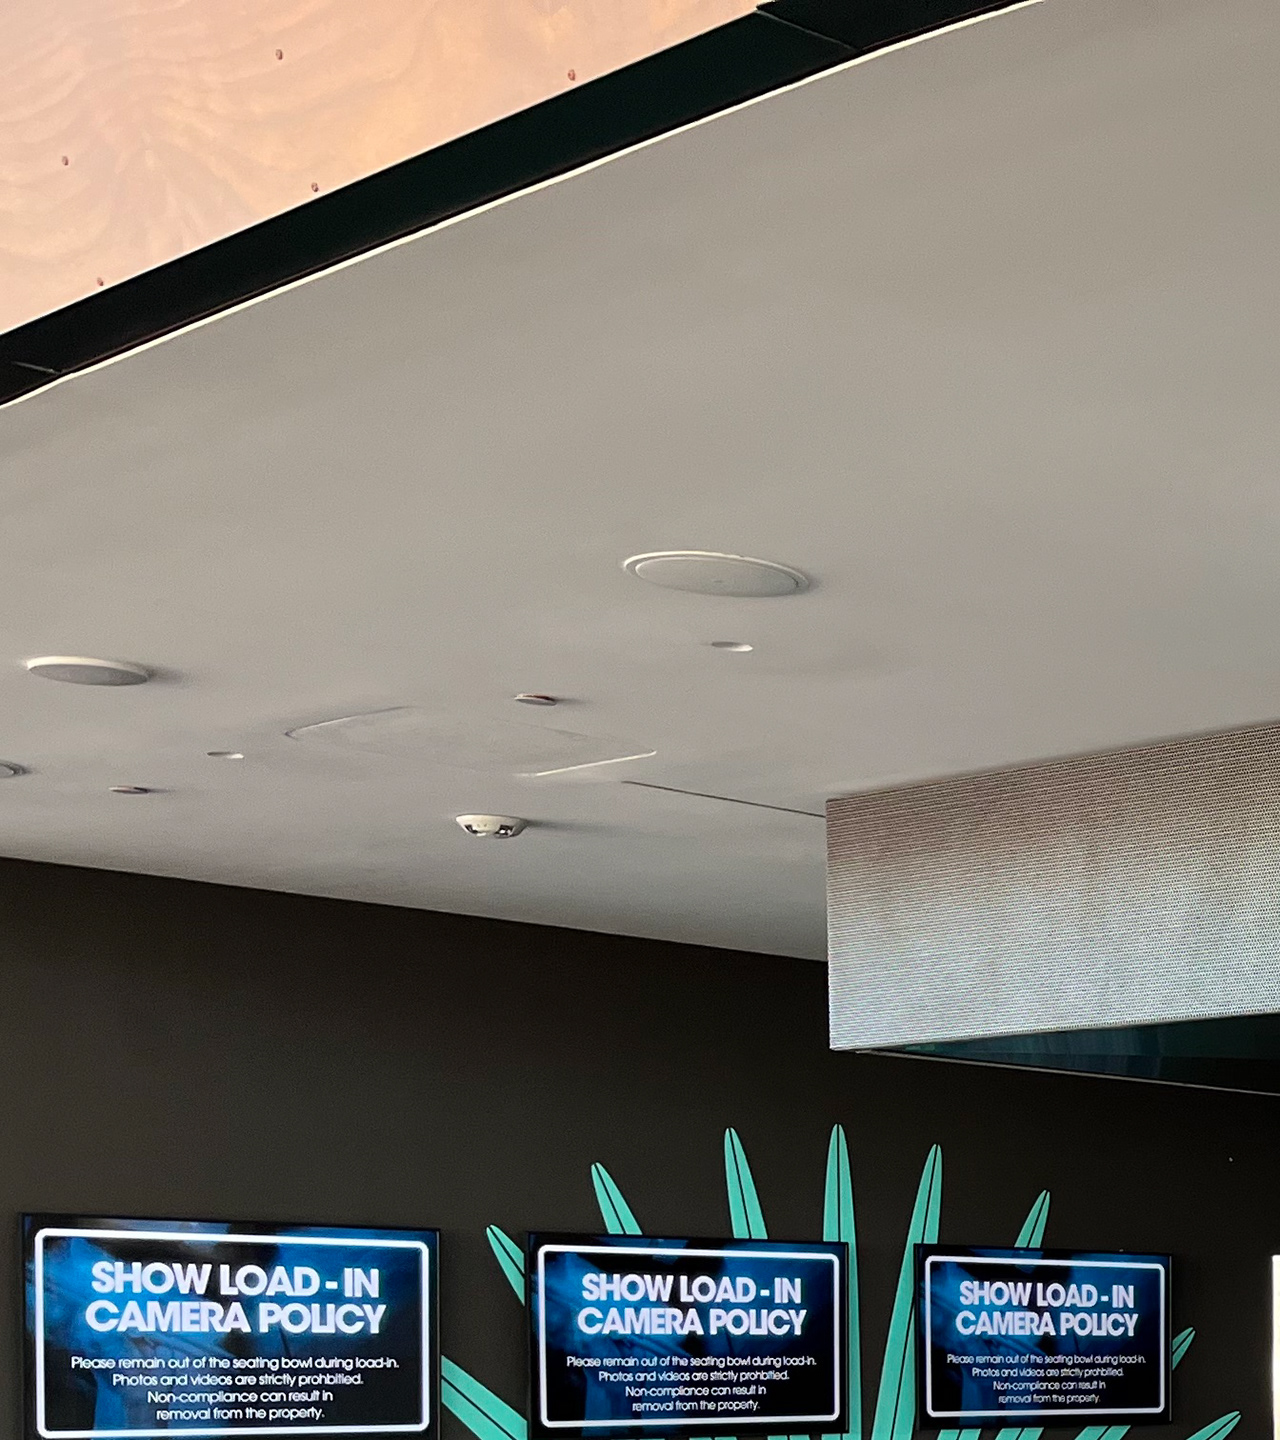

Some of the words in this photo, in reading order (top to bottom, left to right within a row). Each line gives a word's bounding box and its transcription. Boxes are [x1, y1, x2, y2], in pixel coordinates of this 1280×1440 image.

[91, 1261, 212, 1294] SHOW
[582, 1273, 674, 1301] SHOW
[959, 1280, 1032, 1306] SHOW
[85, 1300, 251, 1332] CAMERA
[258, 1302, 386, 1333] POLICY
[577, 1306, 704, 1335] CAMERA
[709, 1308, 806, 1335] POLICY
[955, 1310, 1056, 1335] CAMERA
[1060, 1312, 1138, 1336] POLICY
[70, 1356, 115, 1368] Please
[118, 1357, 165, 1368] remain
[167, 1357, 189, 1368] out
[192, 1356, 206, 1368] of
[208, 1356, 230, 1368] the
[232, 1357, 279, 1370] seating
[281, 1356, 312, 1368] bowl
[314, 1357, 353, 1370] during
[355, 1357, 399, 1368] load-in.
[567, 1356, 601, 1367] Please
[603, 1356, 638, 1366] remain
[640, 1356, 657, 1366] out
[659, 1355, 670, 1366] of
[671, 1356, 688, 1366] the
[690, 1356, 725, 1368] seating
[726, 1355, 750, 1366] bowl
[752, 1355, 781, 1367] during
[783, 1355, 816, 1365] load-in.
[112, 1373, 157, 1385] Photos
[160, 1374, 187, 1385] and
[190, 1374, 232, 1385] videos
[234, 1375, 256, 1385] are
[259, 1373, 296, 1387] strictly
[598, 1371, 633, 1381] Photos
[634, 1371, 656, 1381] and
[657, 1371, 690, 1381] videos
[691, 1372, 708, 1380] are
[709, 1370, 738, 1382] strictly
[147, 1391, 258, 1404] Non-compliance
[260, 1392, 286, 1402] can
[288, 1390, 319, 1401] result
[322, 1390, 333, 1401] in
[625, 1386, 709, 1397] Non-compliance
[710, 1386, 731, 1395] can
[732, 1384, 756, 1395] result
[758, 1384, 766, 1394] in
[632, 1401, 673, 1411] removal
[675, 1400, 698, 1410] from
[699, 1400, 716, 1410] the
[717, 1399, 759, 1411] property.
[156, 1408, 210, 1420] removal
[213, 1407, 242, 1419] from
[245, 1407, 266, 1418] the
[269, 1407, 324, 1420] property.
